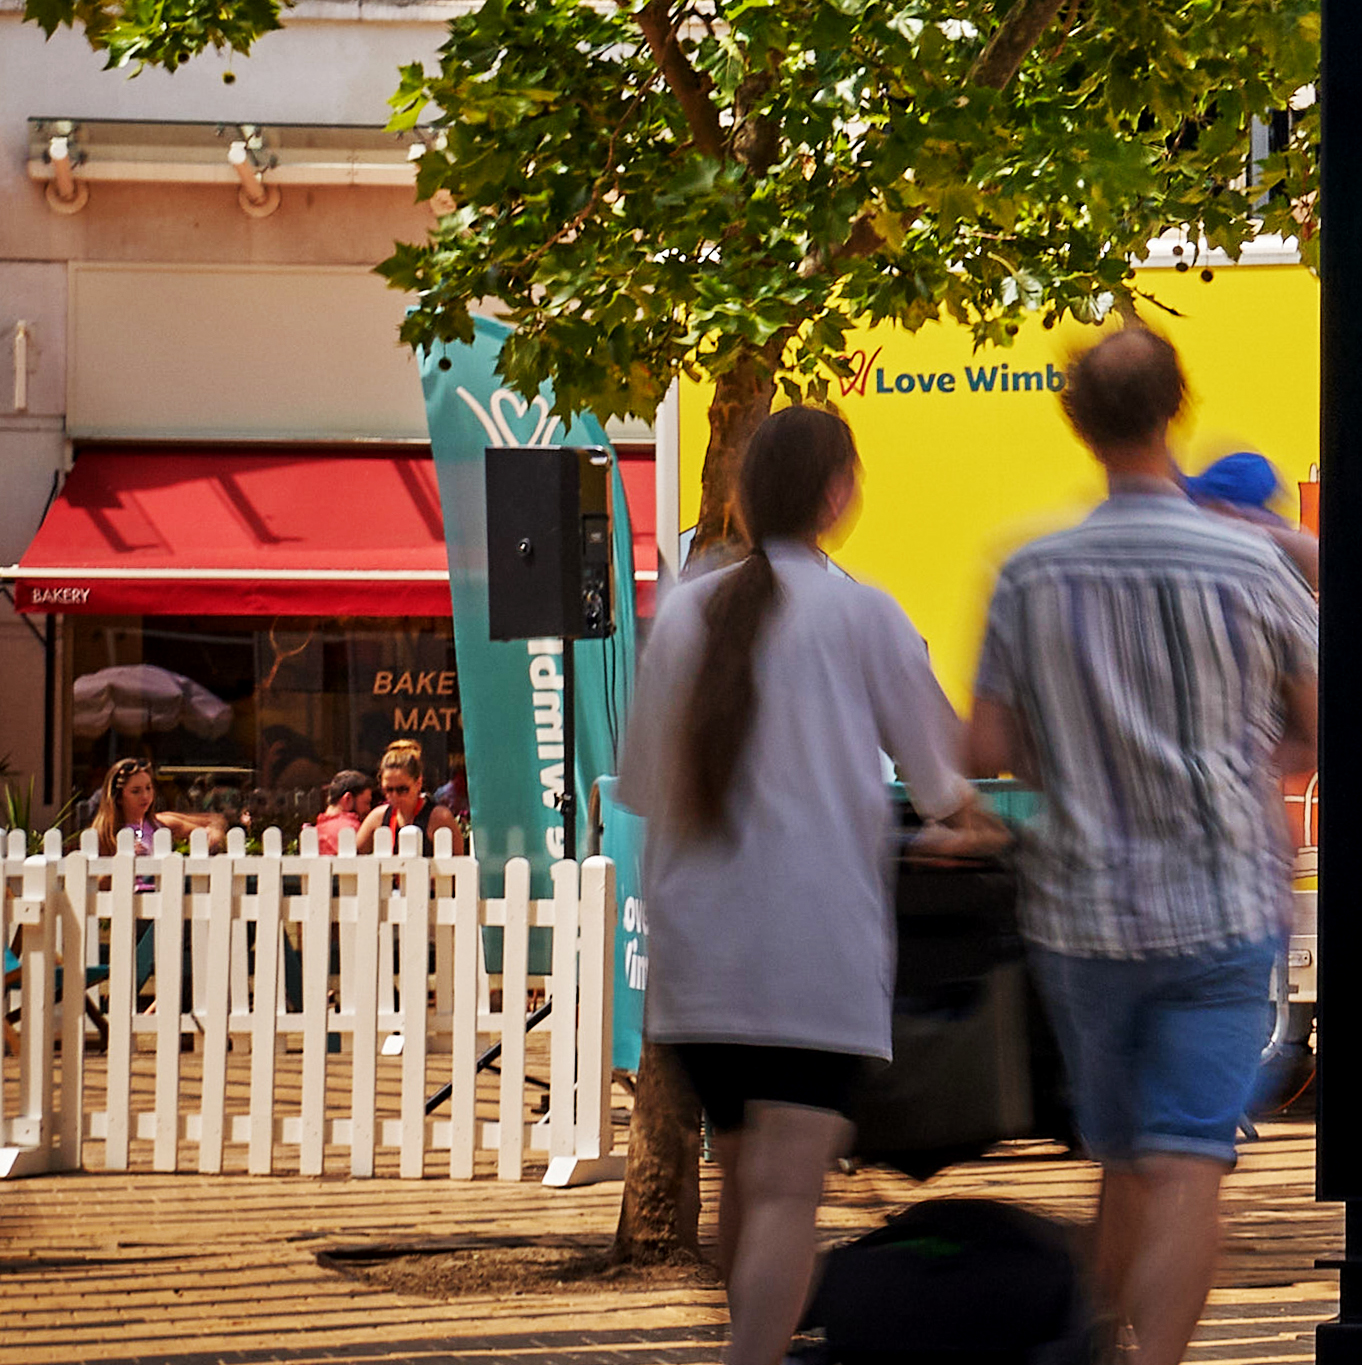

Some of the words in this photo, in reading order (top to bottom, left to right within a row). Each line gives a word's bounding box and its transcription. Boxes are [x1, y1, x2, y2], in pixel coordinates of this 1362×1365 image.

[876, 368, 956, 394] Love
[965, 364, 1066, 393] Wimb
[31, 588, 90, 605] BAKERY
